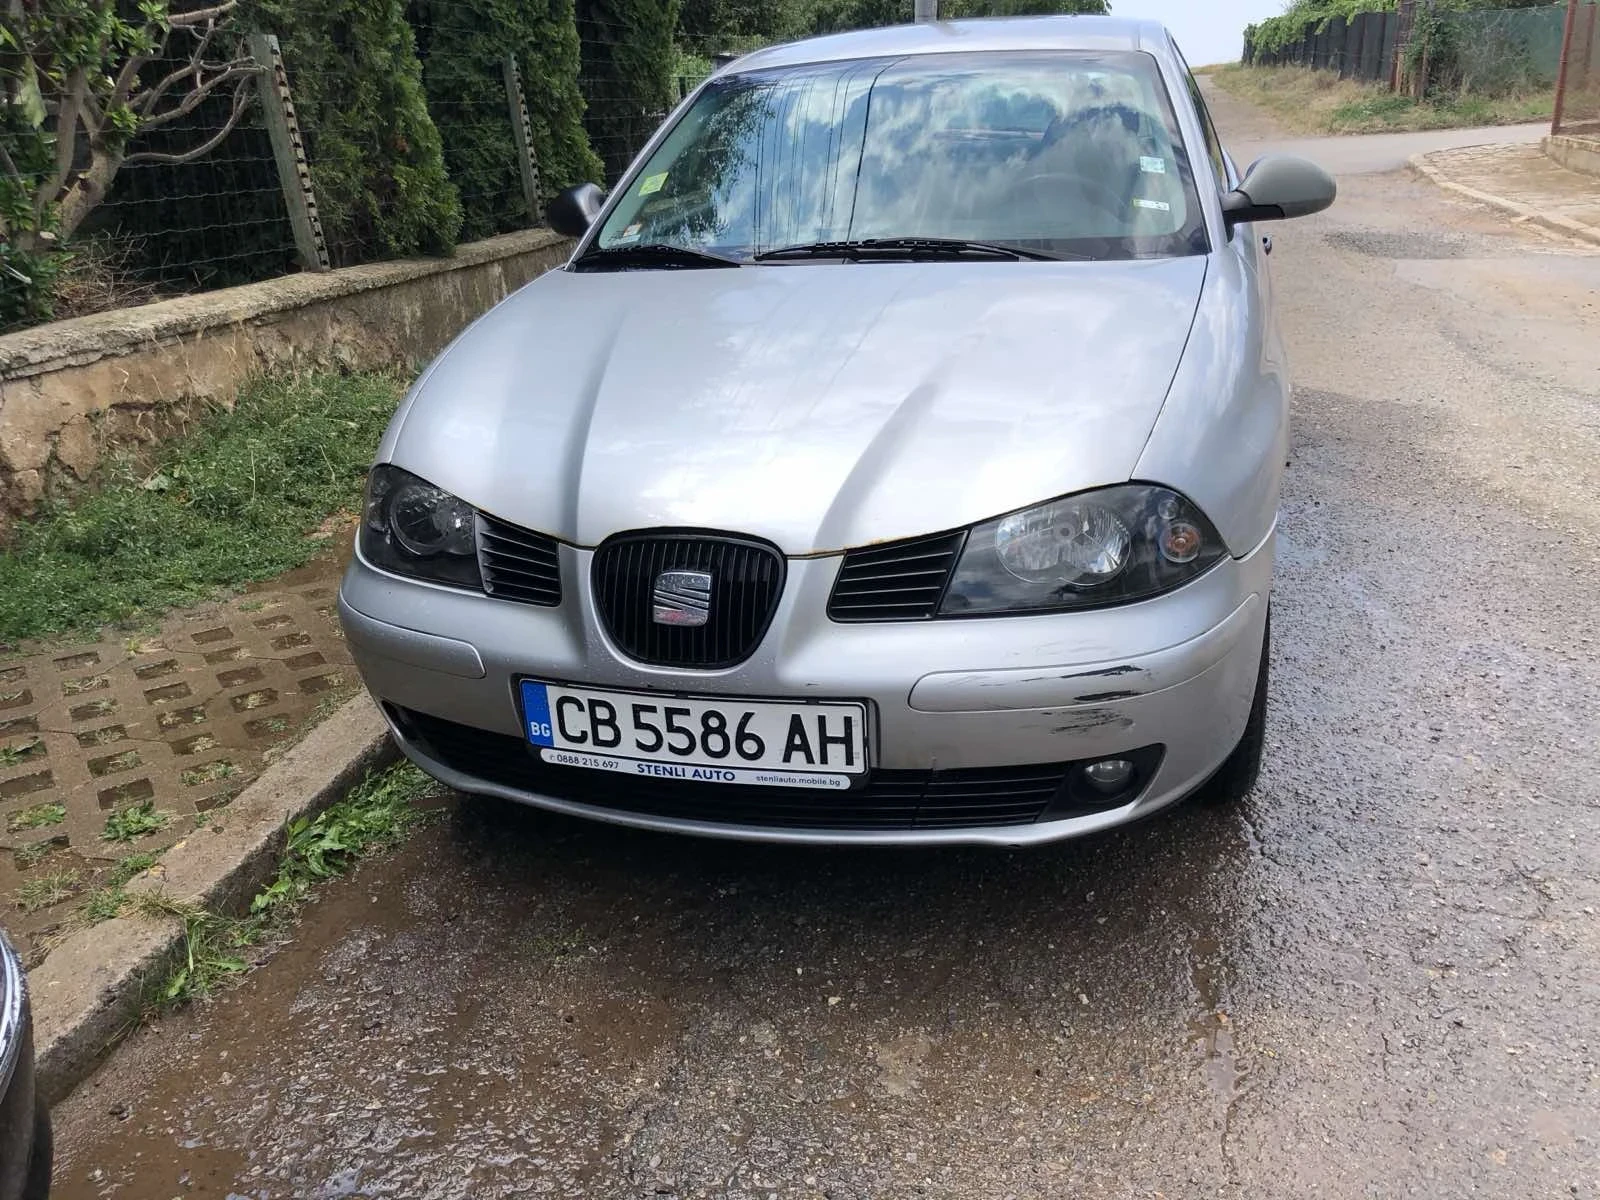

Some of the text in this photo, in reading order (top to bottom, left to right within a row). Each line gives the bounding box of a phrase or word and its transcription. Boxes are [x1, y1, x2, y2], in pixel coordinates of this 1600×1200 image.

[530, 721, 551, 737] BG
[556, 695, 854, 766] CB 5586 AH
[556, 754, 619, 769] 0888 215 697
[637, 763, 736, 782] STENLI AUTO
[756, 775, 841, 787] stenliauto.mobile.bg
